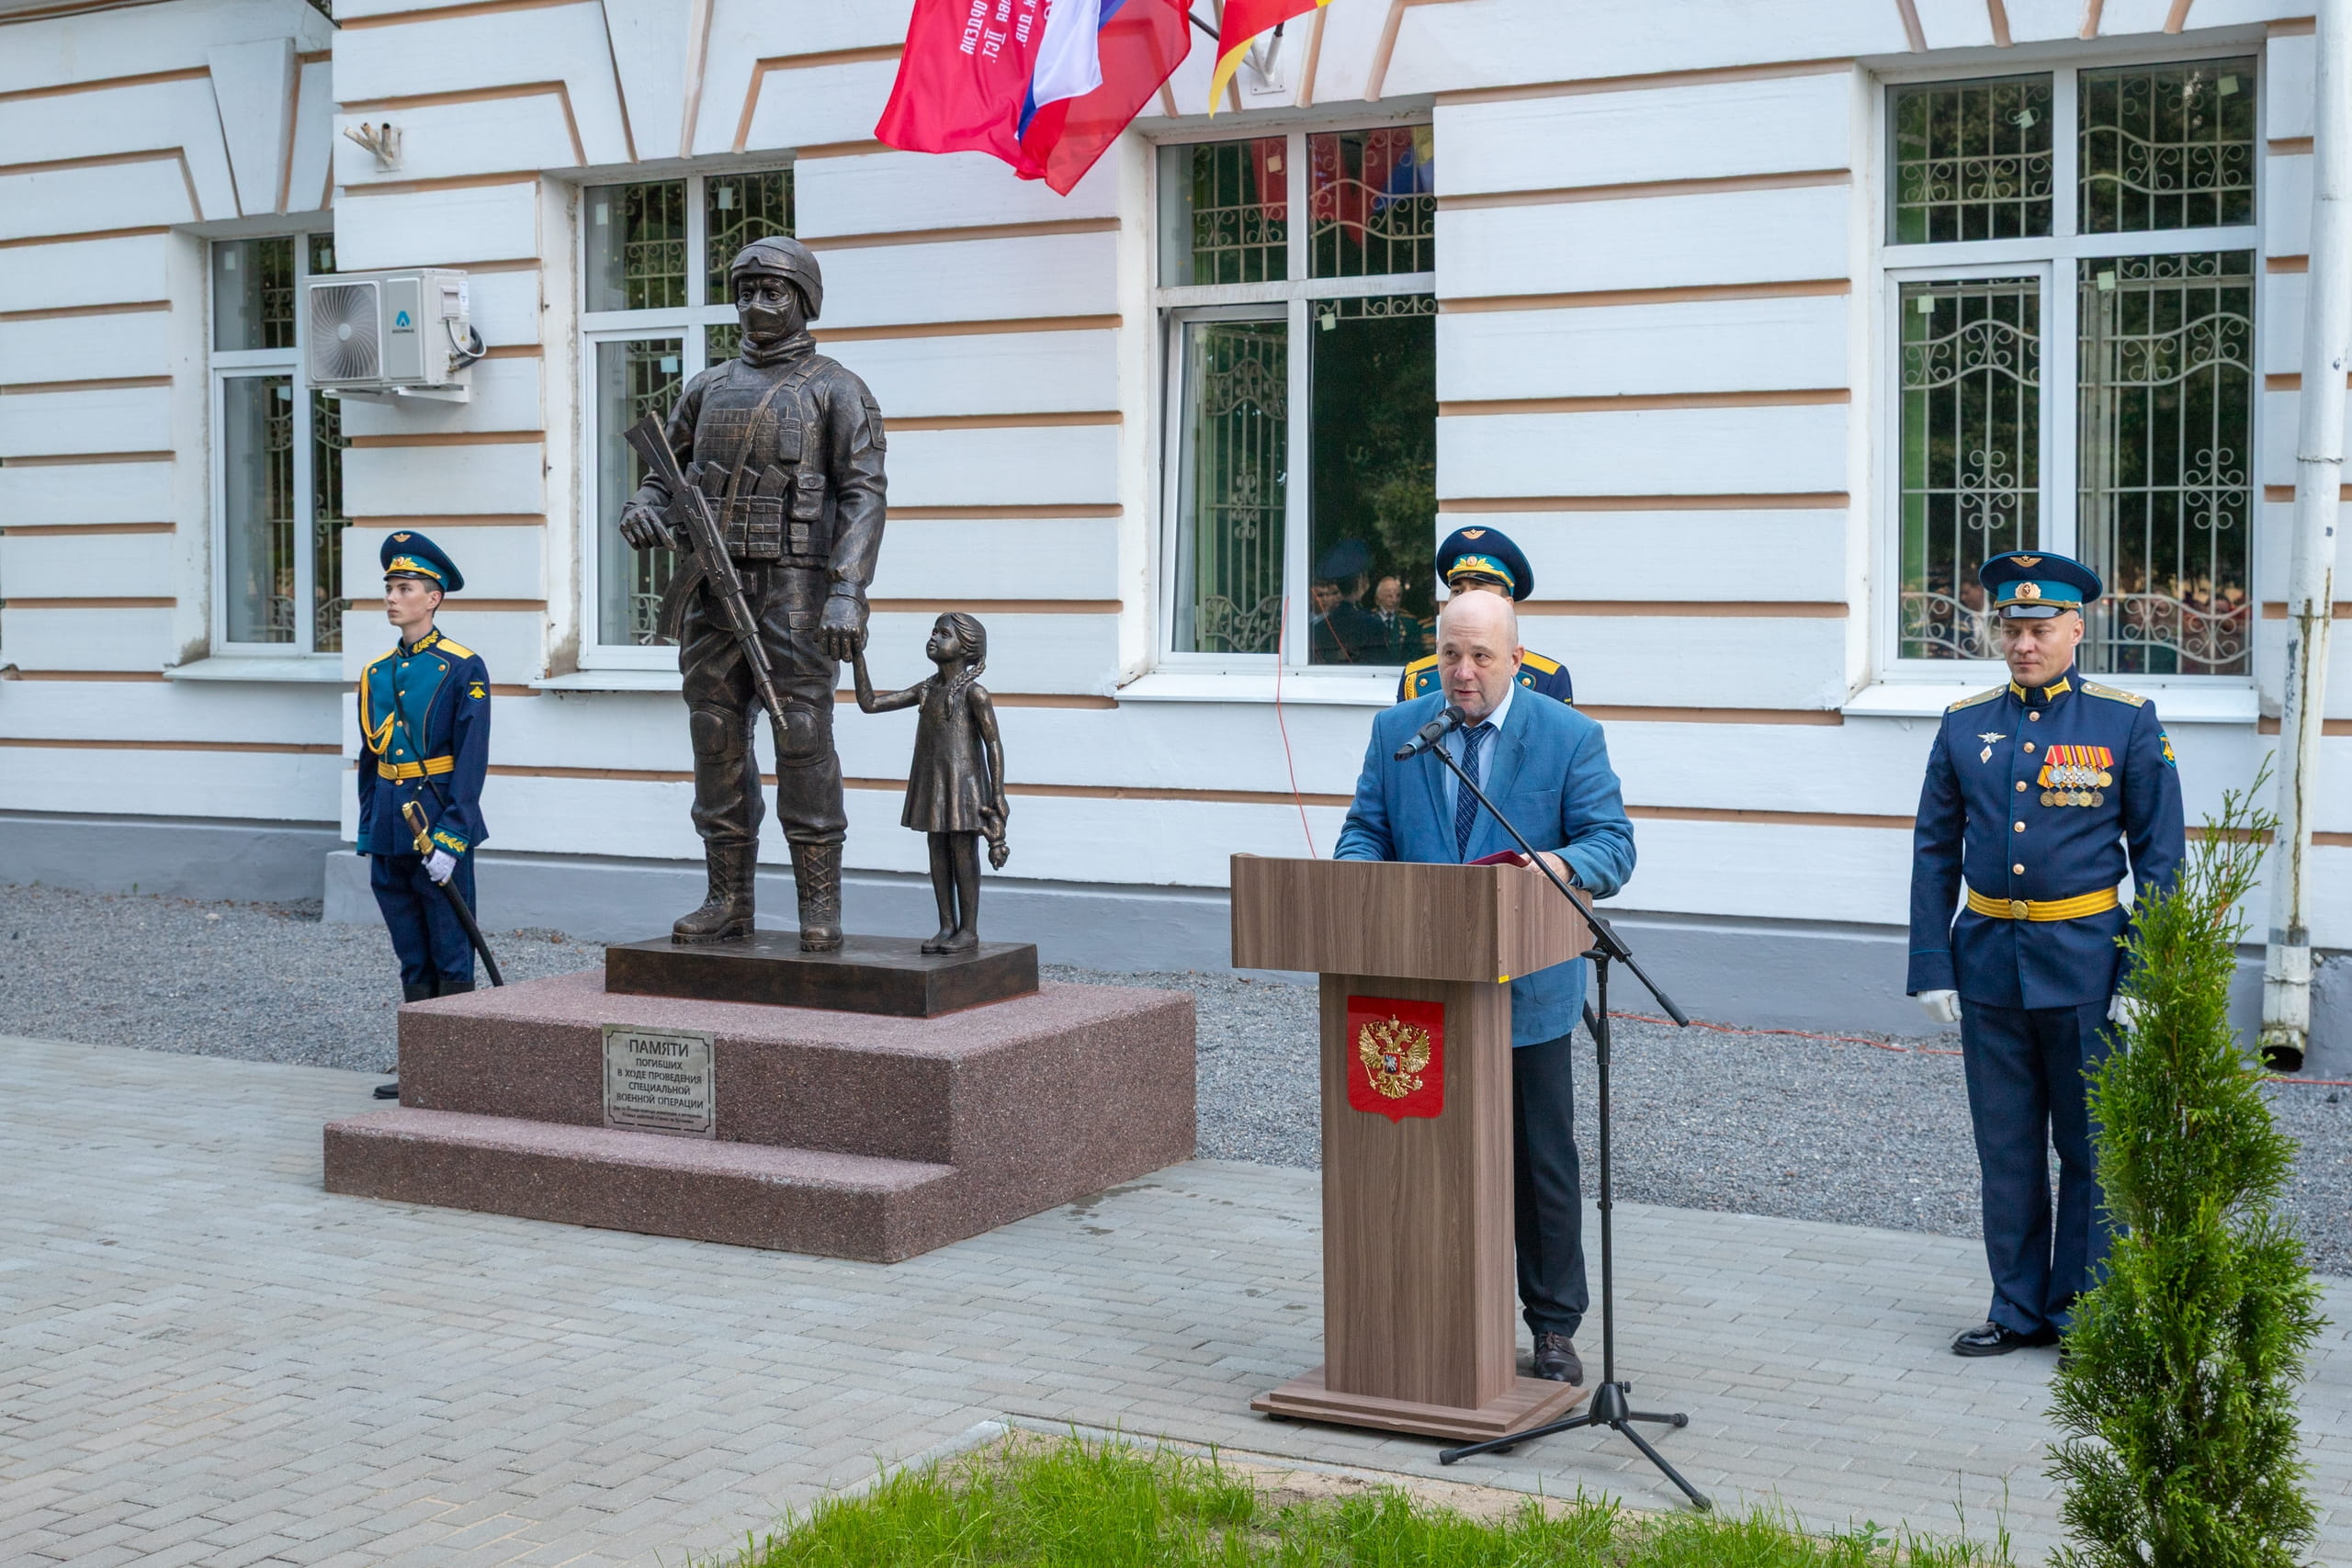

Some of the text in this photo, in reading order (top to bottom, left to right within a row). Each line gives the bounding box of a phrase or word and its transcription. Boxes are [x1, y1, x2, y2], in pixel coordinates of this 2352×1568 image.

[629, 1039, 689, 1057] ПАМЯТИ
[636, 1057, 683, 1070] ПОГИБШИХ
[617, 1068, 702, 1085] В ХОДЕ ПРОВЕДЕНИЯ
[628, 1081, 691, 1096] СПЕЦИАЛЬНОЙ
[616, 1092, 704, 1110] ВОЕННОЙ ОПЕРАЦИИ
